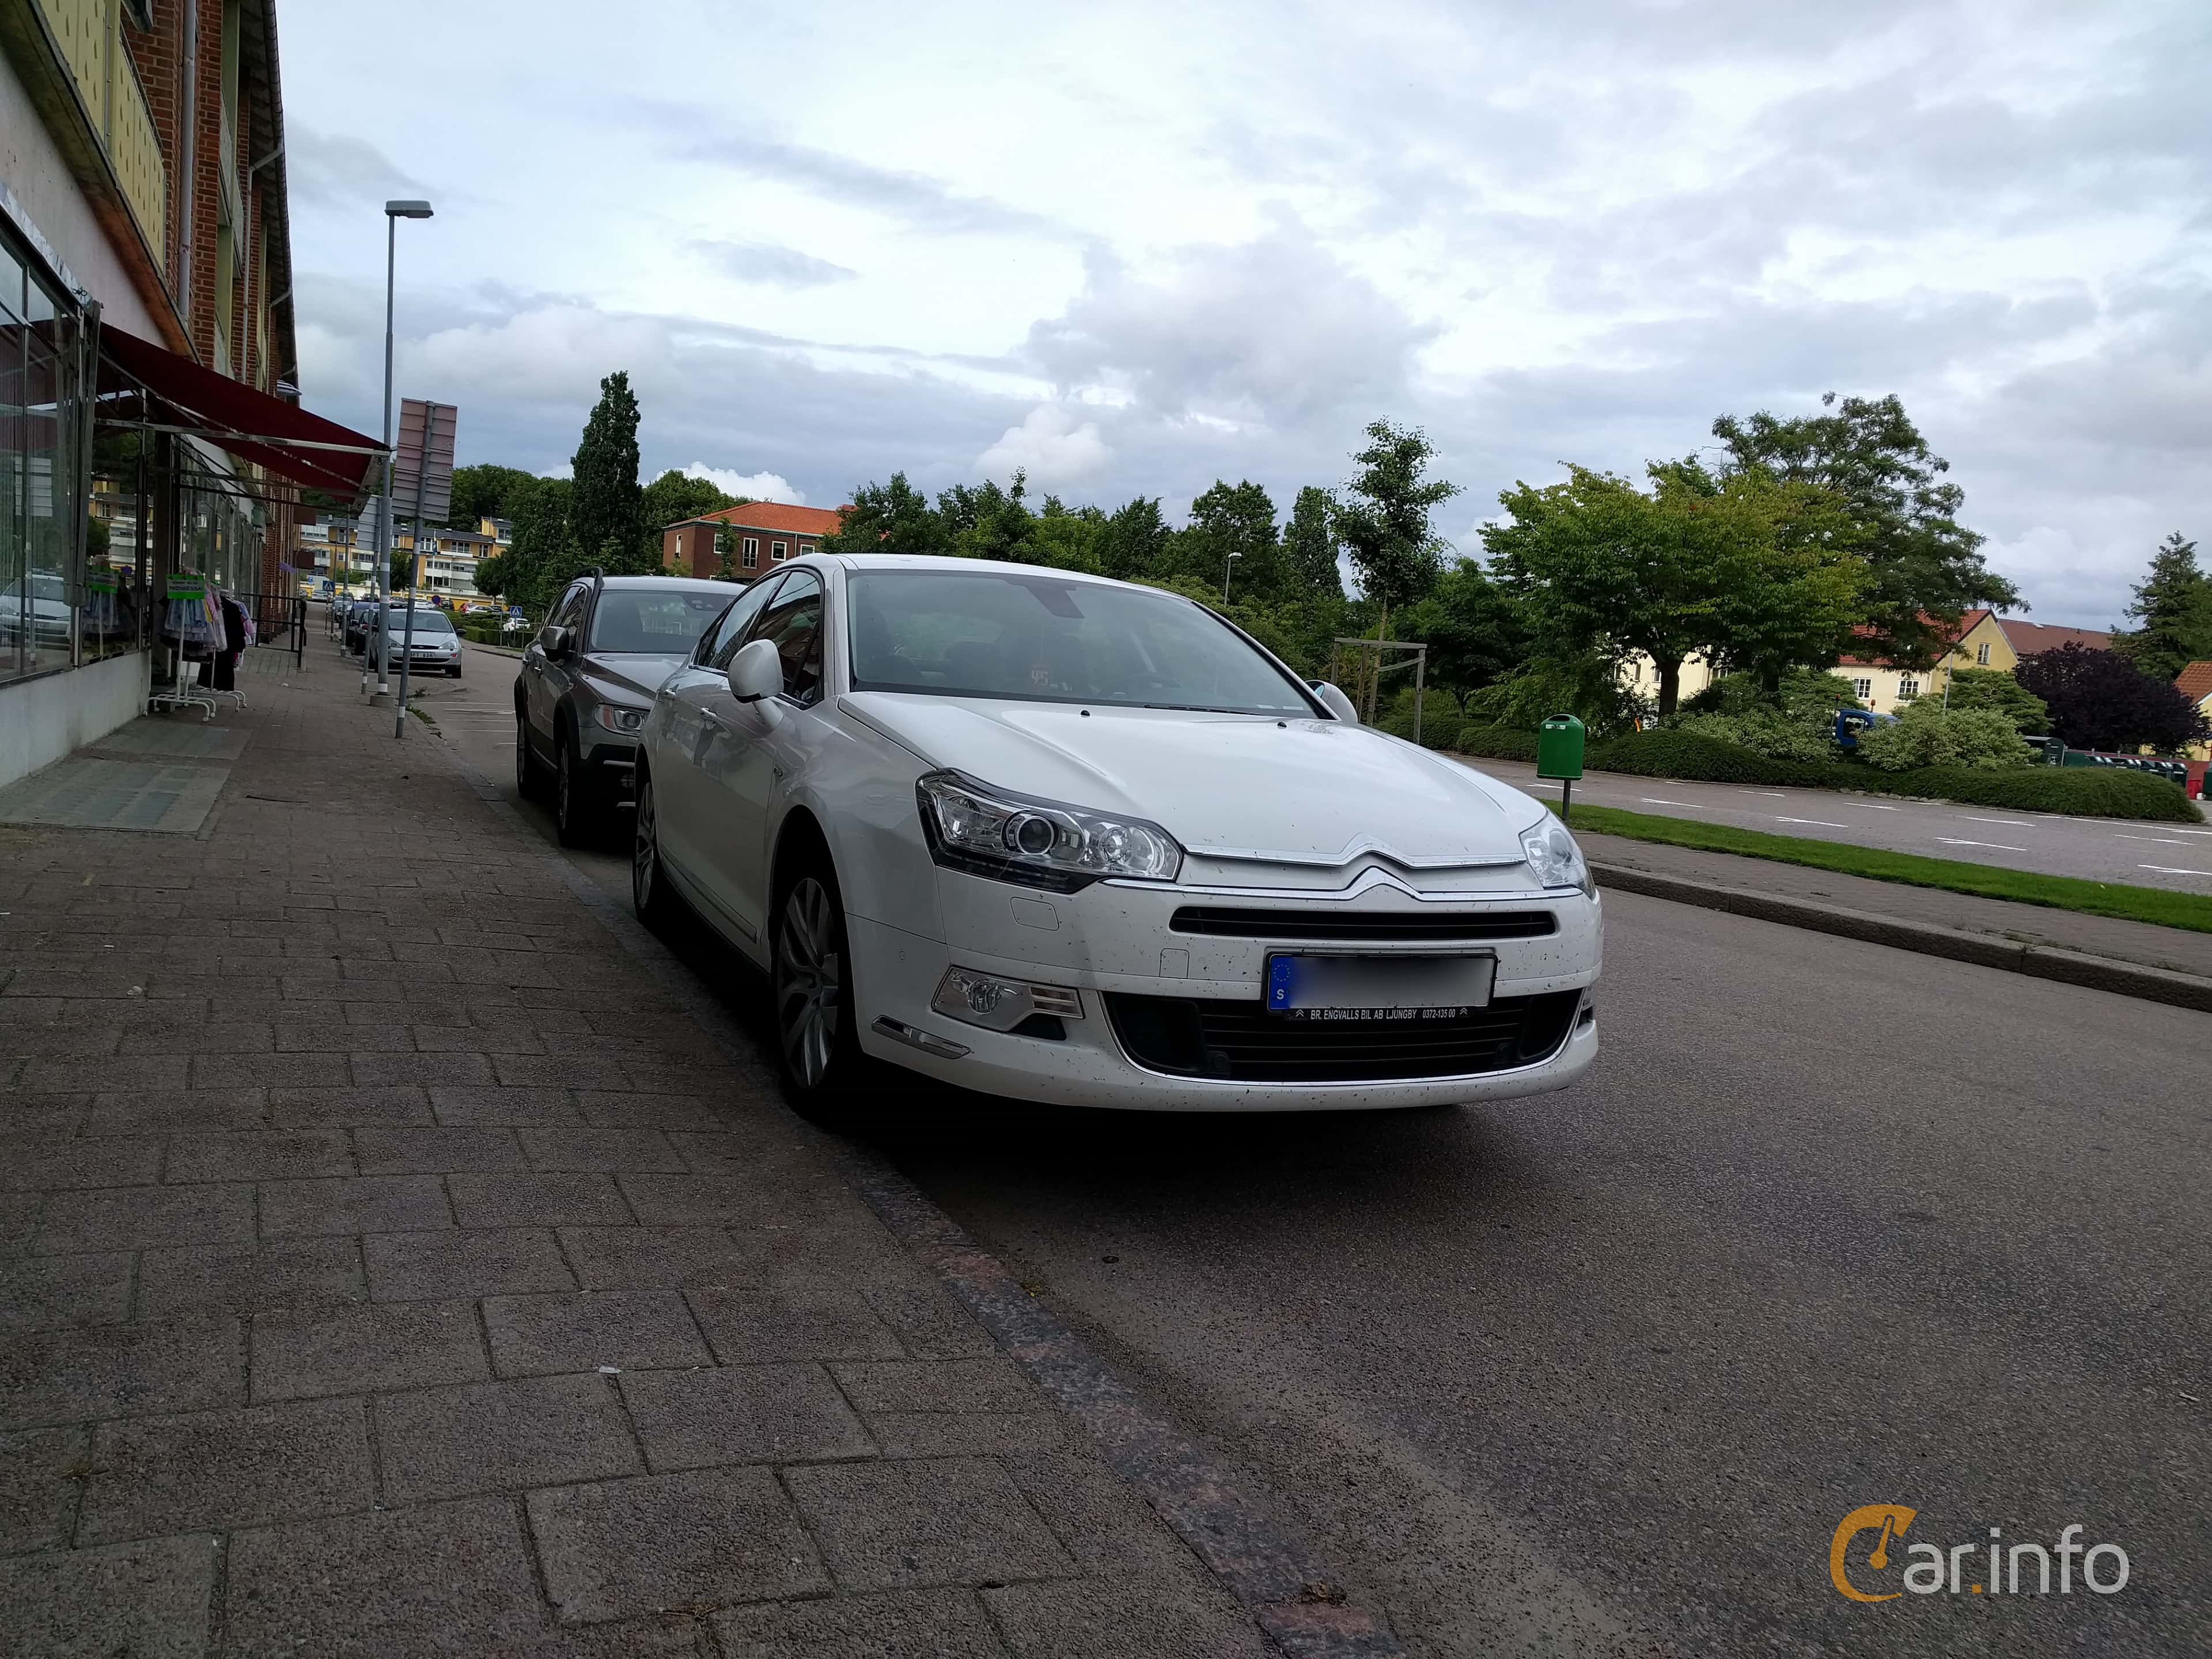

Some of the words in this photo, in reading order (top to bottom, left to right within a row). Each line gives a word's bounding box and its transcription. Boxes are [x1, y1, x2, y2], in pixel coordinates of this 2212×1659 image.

[1277, 989, 1285, 1000] S
[1310, 1010, 1322, 1020] BR.
[1324, 1010, 1359, 1020] ENGVALLS
[1373, 1010, 1384, 1020] AB
[1386, 1009, 1417, 1019] LJUNGBY
[1422, 1009, 1448, 1018] 0372-135
[1448, 1009, 1456, 1018] 00
